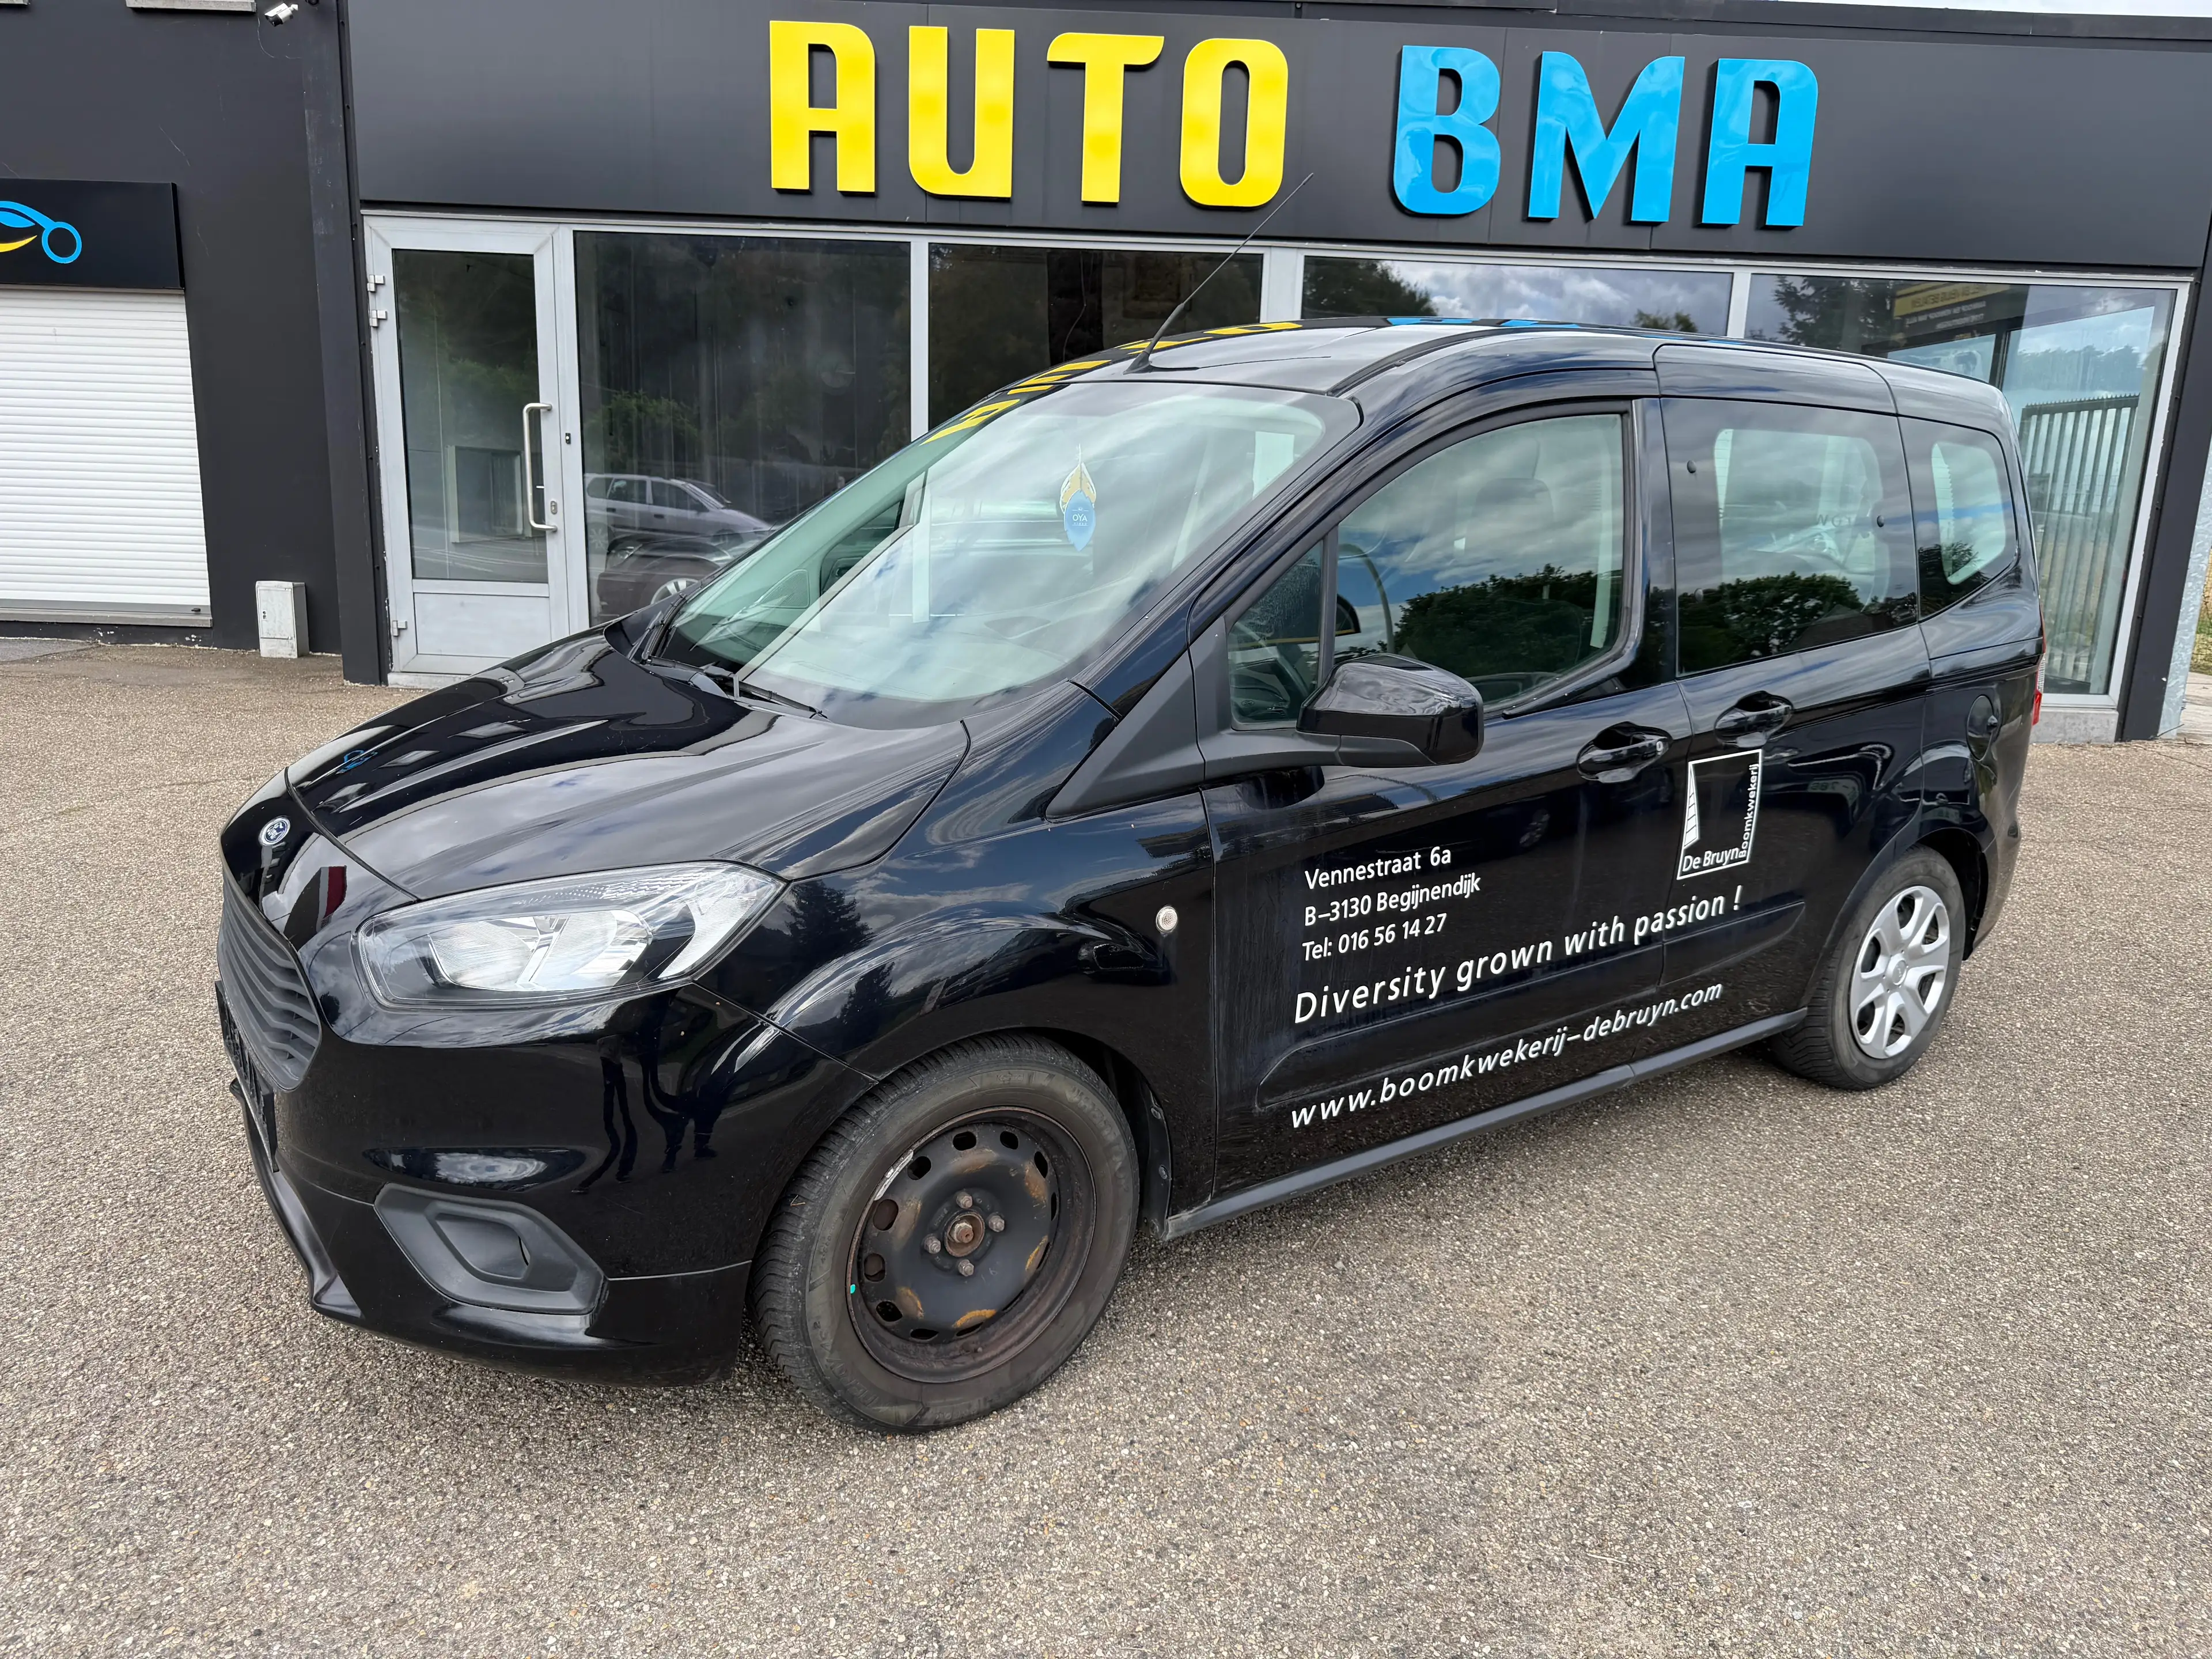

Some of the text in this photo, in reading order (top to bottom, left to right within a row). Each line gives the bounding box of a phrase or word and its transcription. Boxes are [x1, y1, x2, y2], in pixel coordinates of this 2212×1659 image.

[770, 20, 1819, 228] AUTO BMA
[1072, 513, 1088, 521] OYA
[1738, 763, 1759, 858] Boomkwekerij
[1305, 846, 1451, 889] Vennestraat 6a
[1682, 846, 1740, 872] De Bruyn
[1305, 872, 1481, 926] B-3130 Begijnendijk
[1295, 885, 1743, 1024] Diversity grown with passion !
[1302, 912, 1447, 961] Tel: 016 56 14 27
[1291, 983, 1723, 1128] www.boomkwekerij-debruyn.com
